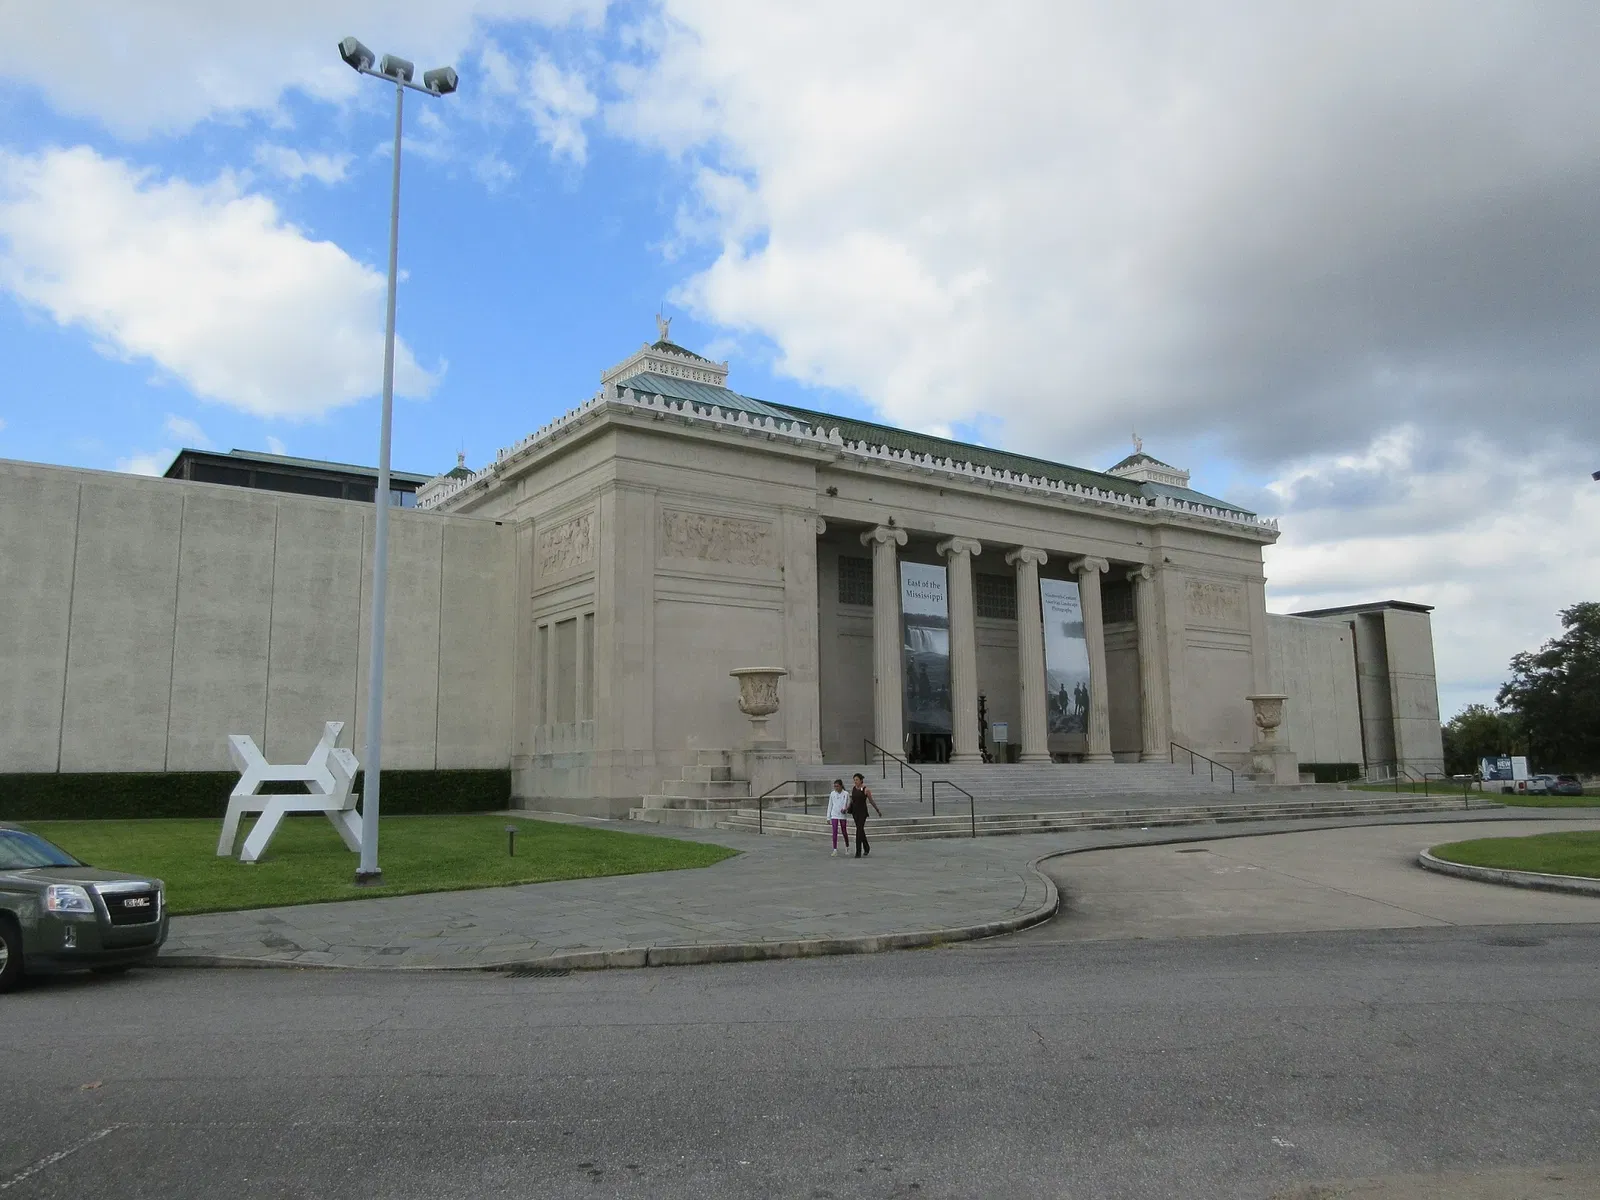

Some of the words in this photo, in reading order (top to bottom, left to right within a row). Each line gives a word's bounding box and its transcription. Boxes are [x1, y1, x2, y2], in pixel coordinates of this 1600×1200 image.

[907, 578, 921, 587] East
[921, 580, 929, 588] of
[930, 581, 941, 590] the
[906, 589, 943, 602] Mississippi
[1497, 760, 1511, 768] NEW
[124, 897, 150, 908] GMC
